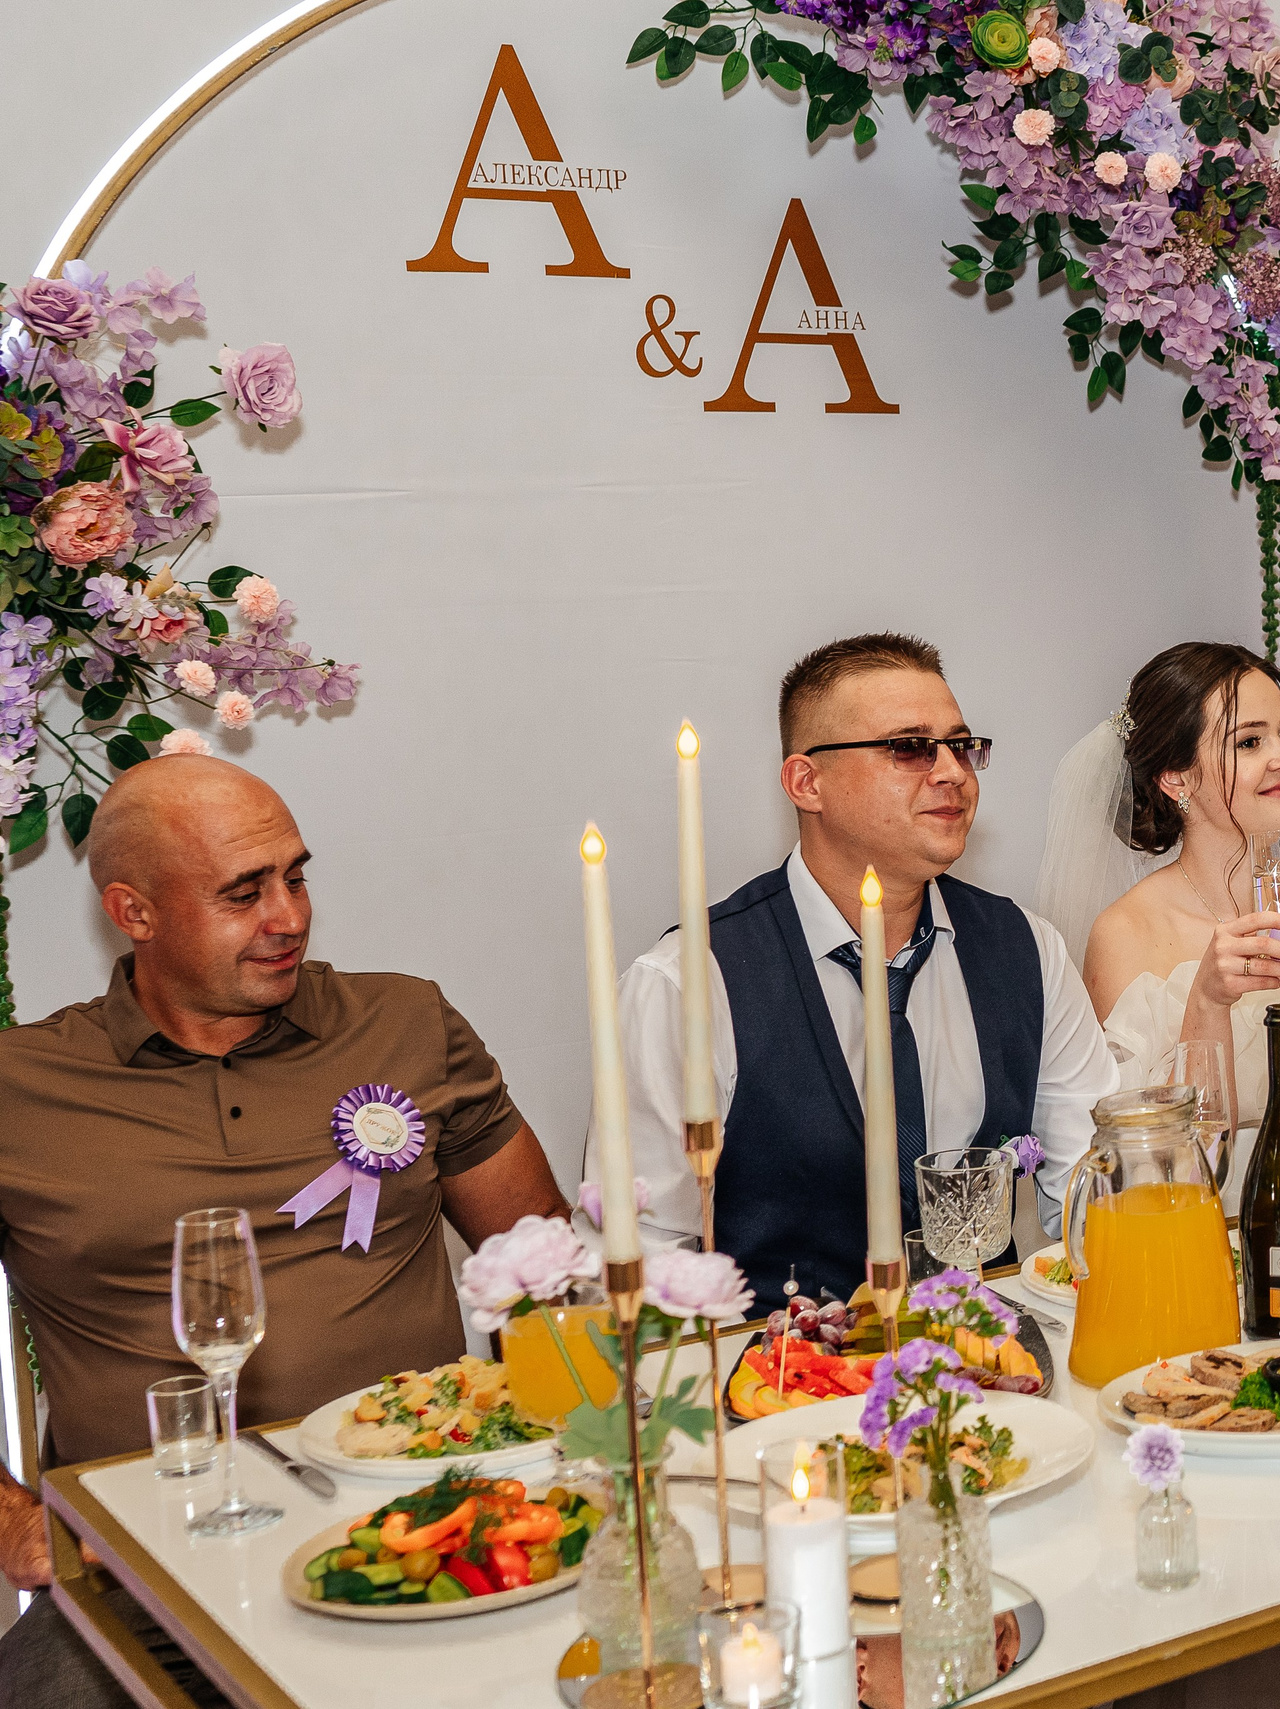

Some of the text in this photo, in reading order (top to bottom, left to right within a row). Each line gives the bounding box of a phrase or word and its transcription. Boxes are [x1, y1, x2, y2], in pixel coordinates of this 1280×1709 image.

[472, 162, 628, 194] АЛЕКСАНДР
[635, 293, 703, 378] &
[797, 309, 866, 331] АННА
